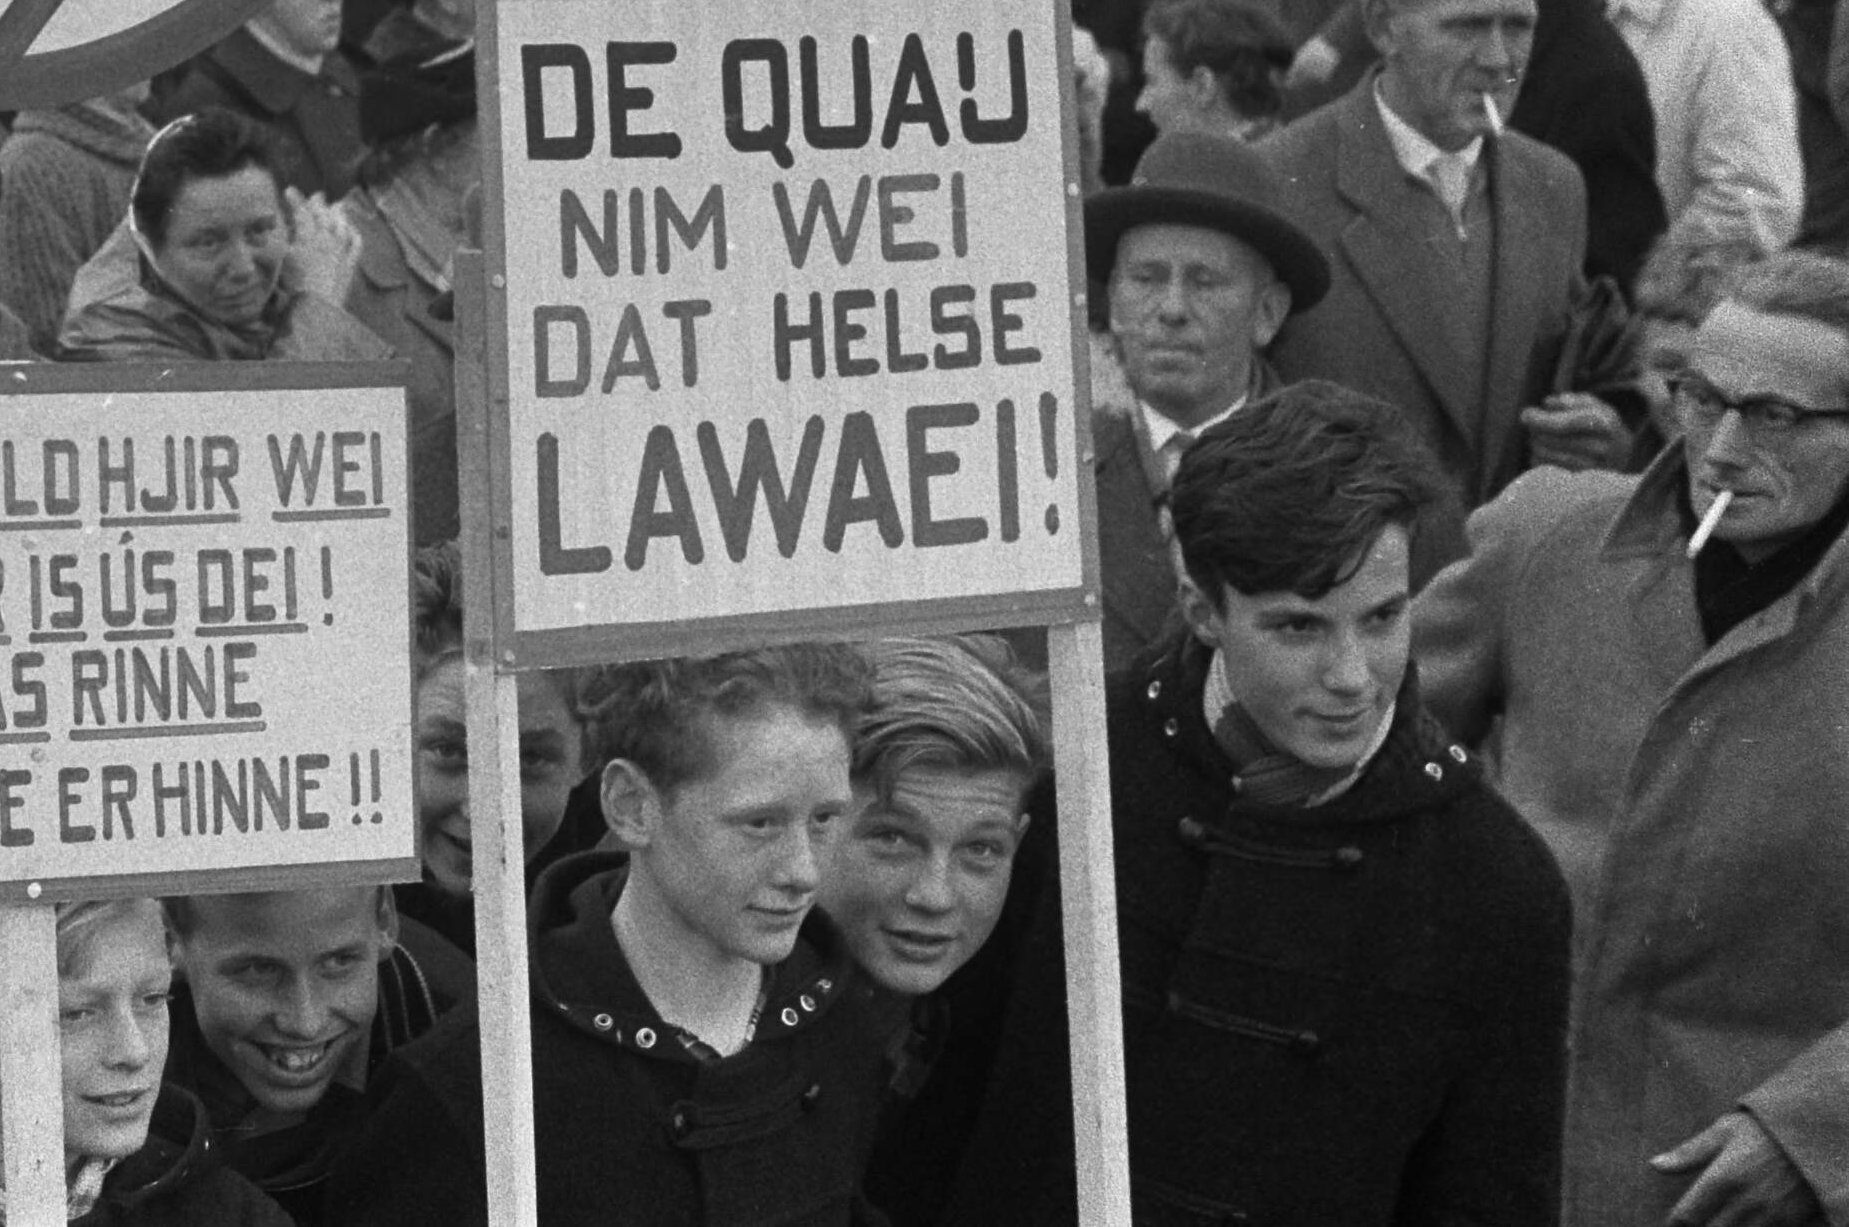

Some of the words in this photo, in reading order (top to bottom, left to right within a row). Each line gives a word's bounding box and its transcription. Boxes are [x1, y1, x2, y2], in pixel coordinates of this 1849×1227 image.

[521, 41, 683, 161] DE
[559, 184, 728, 279] NIM
[773, 172, 968, 270] WEI
[533, 300, 712, 398] DAT
[774, 282, 1042, 381] HELSE
[99, 435, 240, 517] HJIR
[268, 430, 384, 506] WEI
[29, 553, 85, 633] IS
[100, 530, 177, 630] ÚS
[71, 641, 262, 727] RINNE
[58, 764, 139, 843] ER
